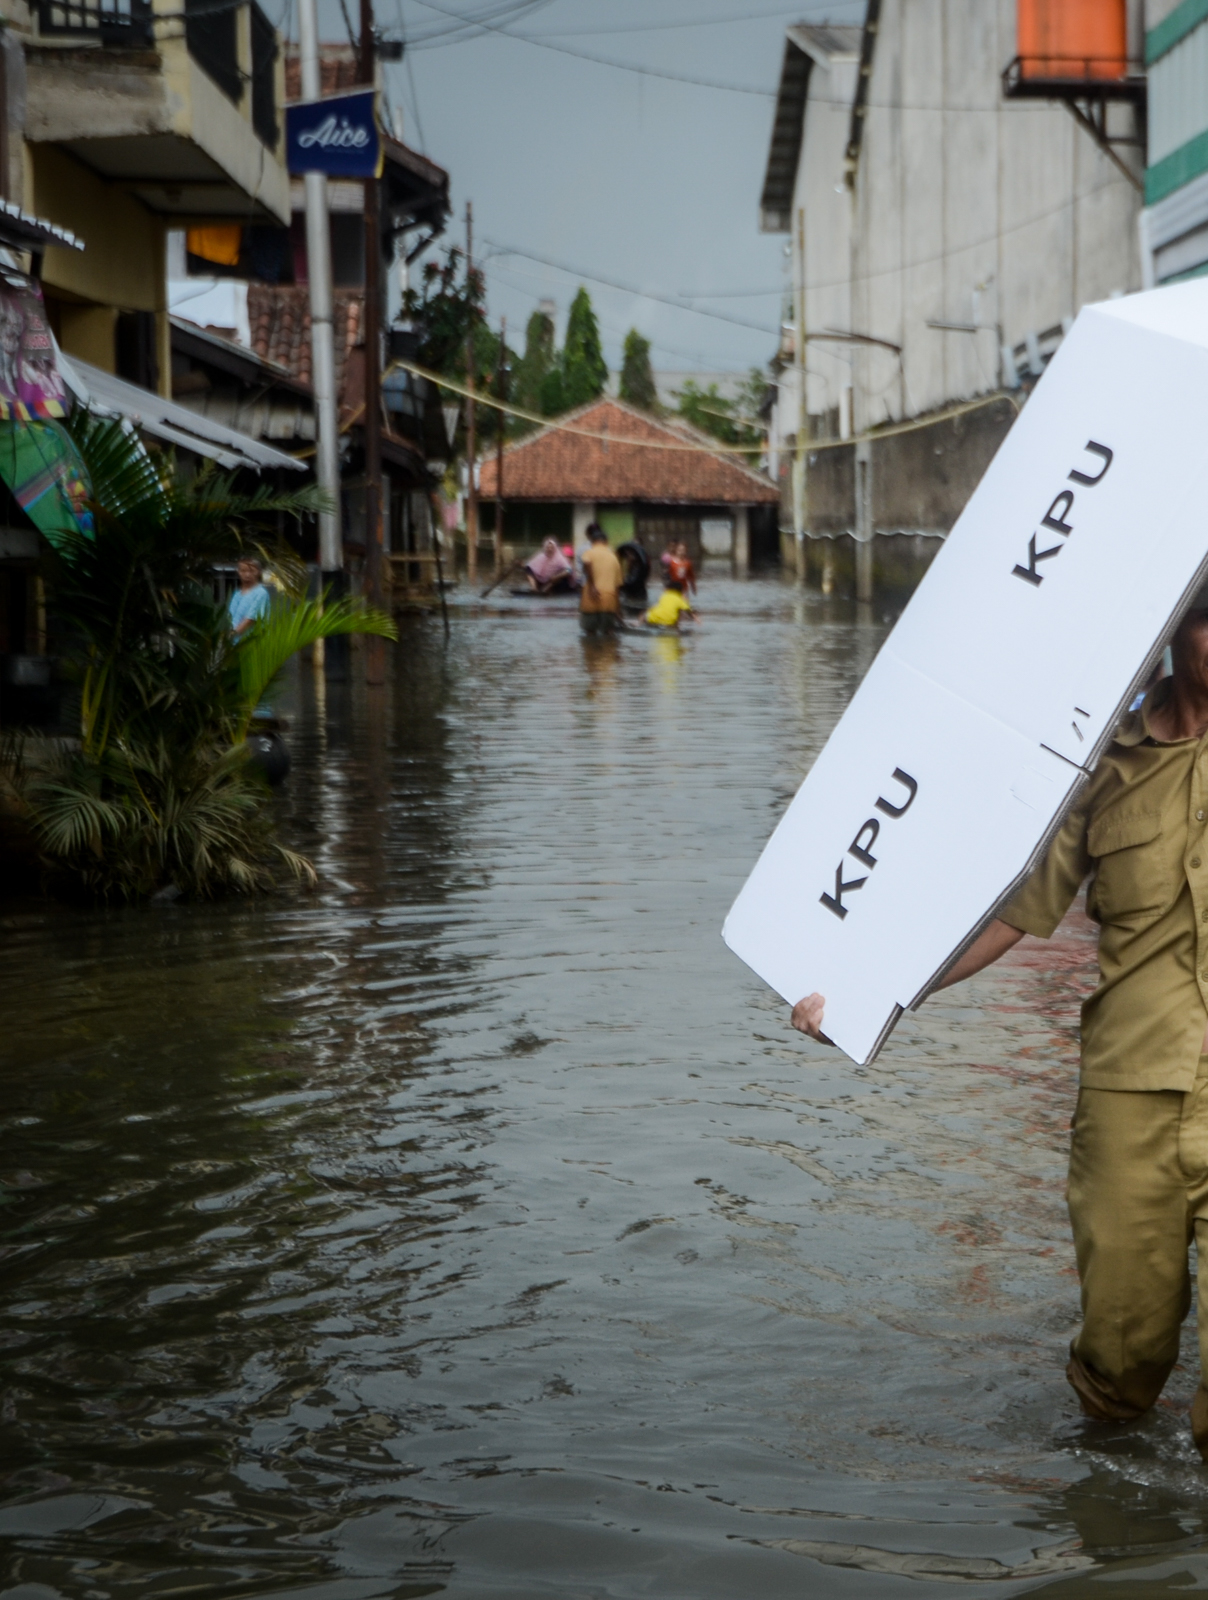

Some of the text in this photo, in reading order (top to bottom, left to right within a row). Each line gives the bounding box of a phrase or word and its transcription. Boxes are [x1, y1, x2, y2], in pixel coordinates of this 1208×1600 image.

[298, 117, 370, 149] Aice
[1011, 439, 1114, 588] KPU
[818, 766, 918, 921] KPU
